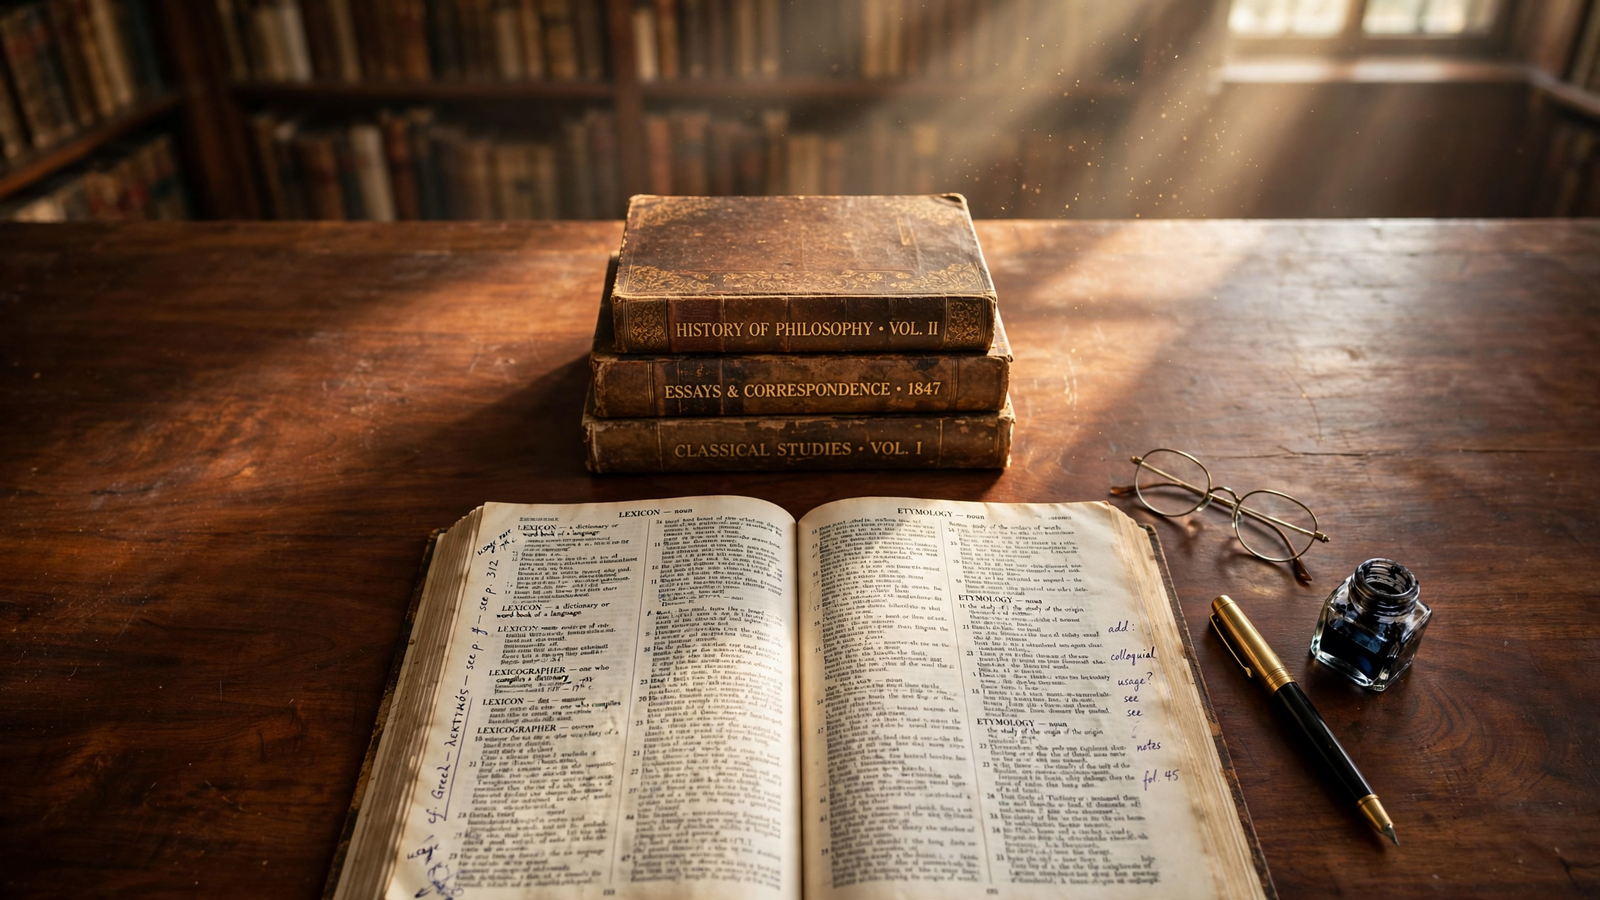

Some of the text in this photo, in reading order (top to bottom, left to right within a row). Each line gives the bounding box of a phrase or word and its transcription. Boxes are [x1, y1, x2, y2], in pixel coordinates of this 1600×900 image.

[676, 322, 744, 338] HISTORY
[750, 321, 769, 337] OF
[775, 321, 873, 337] PHILOSOPHY
[889, 321, 923, 336] VOL.
[927, 321, 939, 336] II
[664, 384, 722, 400] ESSAYS
[727, 384, 739, 398] &
[744, 382, 890, 398] CORRESPONDENCE
[907, 381, 941, 396] 1847
[674, 442, 770, 458] CLASSICAL
[777, 441, 851, 457] STUDIES
[870, 441, 908, 456] VOL.
[916, 441, 922, 456] I
[618, 508, 660, 518] LEXICON
[897, 507, 953, 518] ETYMOLOGY
[479, 596, 489, 611] see
[486, 559, 499, 578] 312
[958, 594, 1013, 604] ETYMOLOGY
[501, 604, 542, 612] LEXICON
[497, 625, 539, 633] LEXICON
[1110, 646, 1156, 665] colloquial
[466, 653, 476, 670] see
[488, 666, 566, 677] LEXICOGRAPHER
[1117, 671, 1153, 691] usage?
[482, 697, 524, 706] LEXICON
[1124, 694, 1139, 703] see
[1126, 708, 1144, 717] see
[976, 718, 1035, 727] ETYMOLOGY
[477, 724, 557, 734] LEXICOGRAPHER
[1164, 769, 1180, 782] 45
